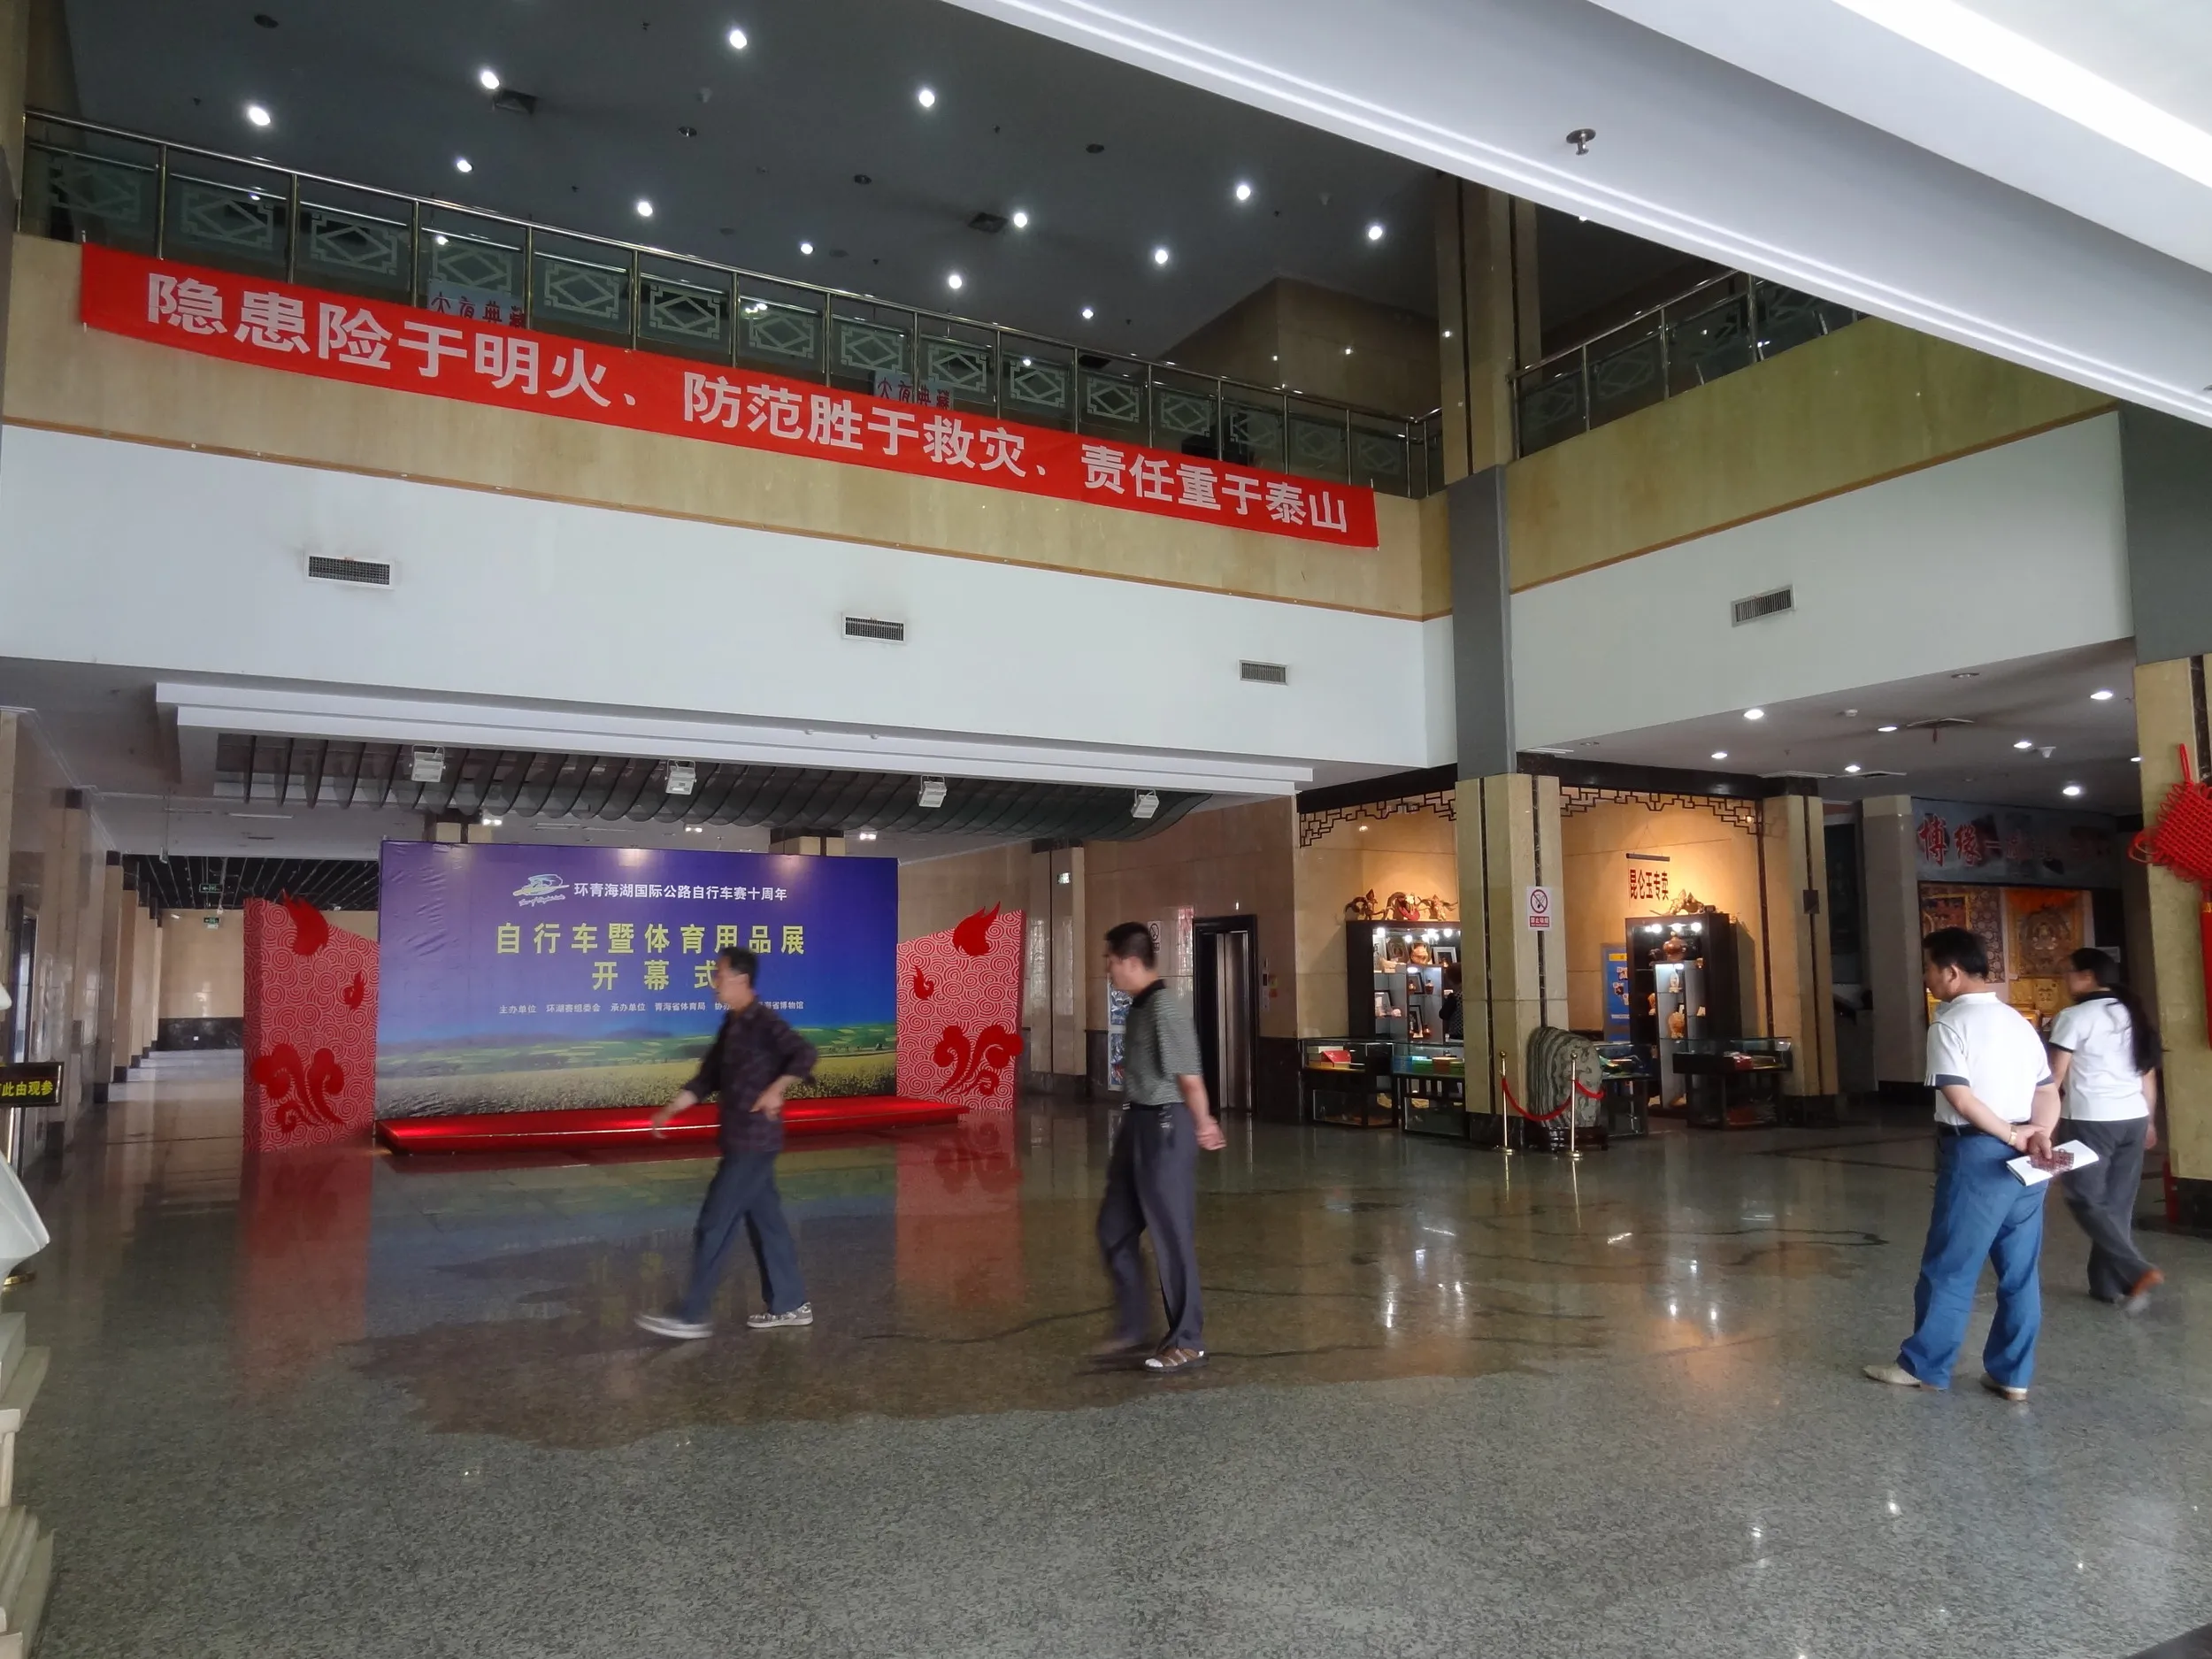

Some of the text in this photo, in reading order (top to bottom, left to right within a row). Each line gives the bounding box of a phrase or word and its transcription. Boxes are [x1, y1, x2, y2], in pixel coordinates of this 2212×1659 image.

[148, 273, 1348, 533] 隐患险于明火、防范胜于救灾、责任重于泰山
[573, 882, 787, 901] 环青海湖国际公路自行车赛十周年
[1630, 869, 1670, 902] 昆仑玉专卖
[497, 923, 804, 955] 自行车暨体育用品展
[592, 960, 718, 990] 开幕式
[499, 1004, 537, 1014] 主办单位
[546, 1002, 601, 1013] 环湖赛组委会
[611, 1002, 646, 1012] 承办单位
[655, 1002, 706, 1011] 青海省体育局
[758, 1001, 804, 1010] 海省博物馆
